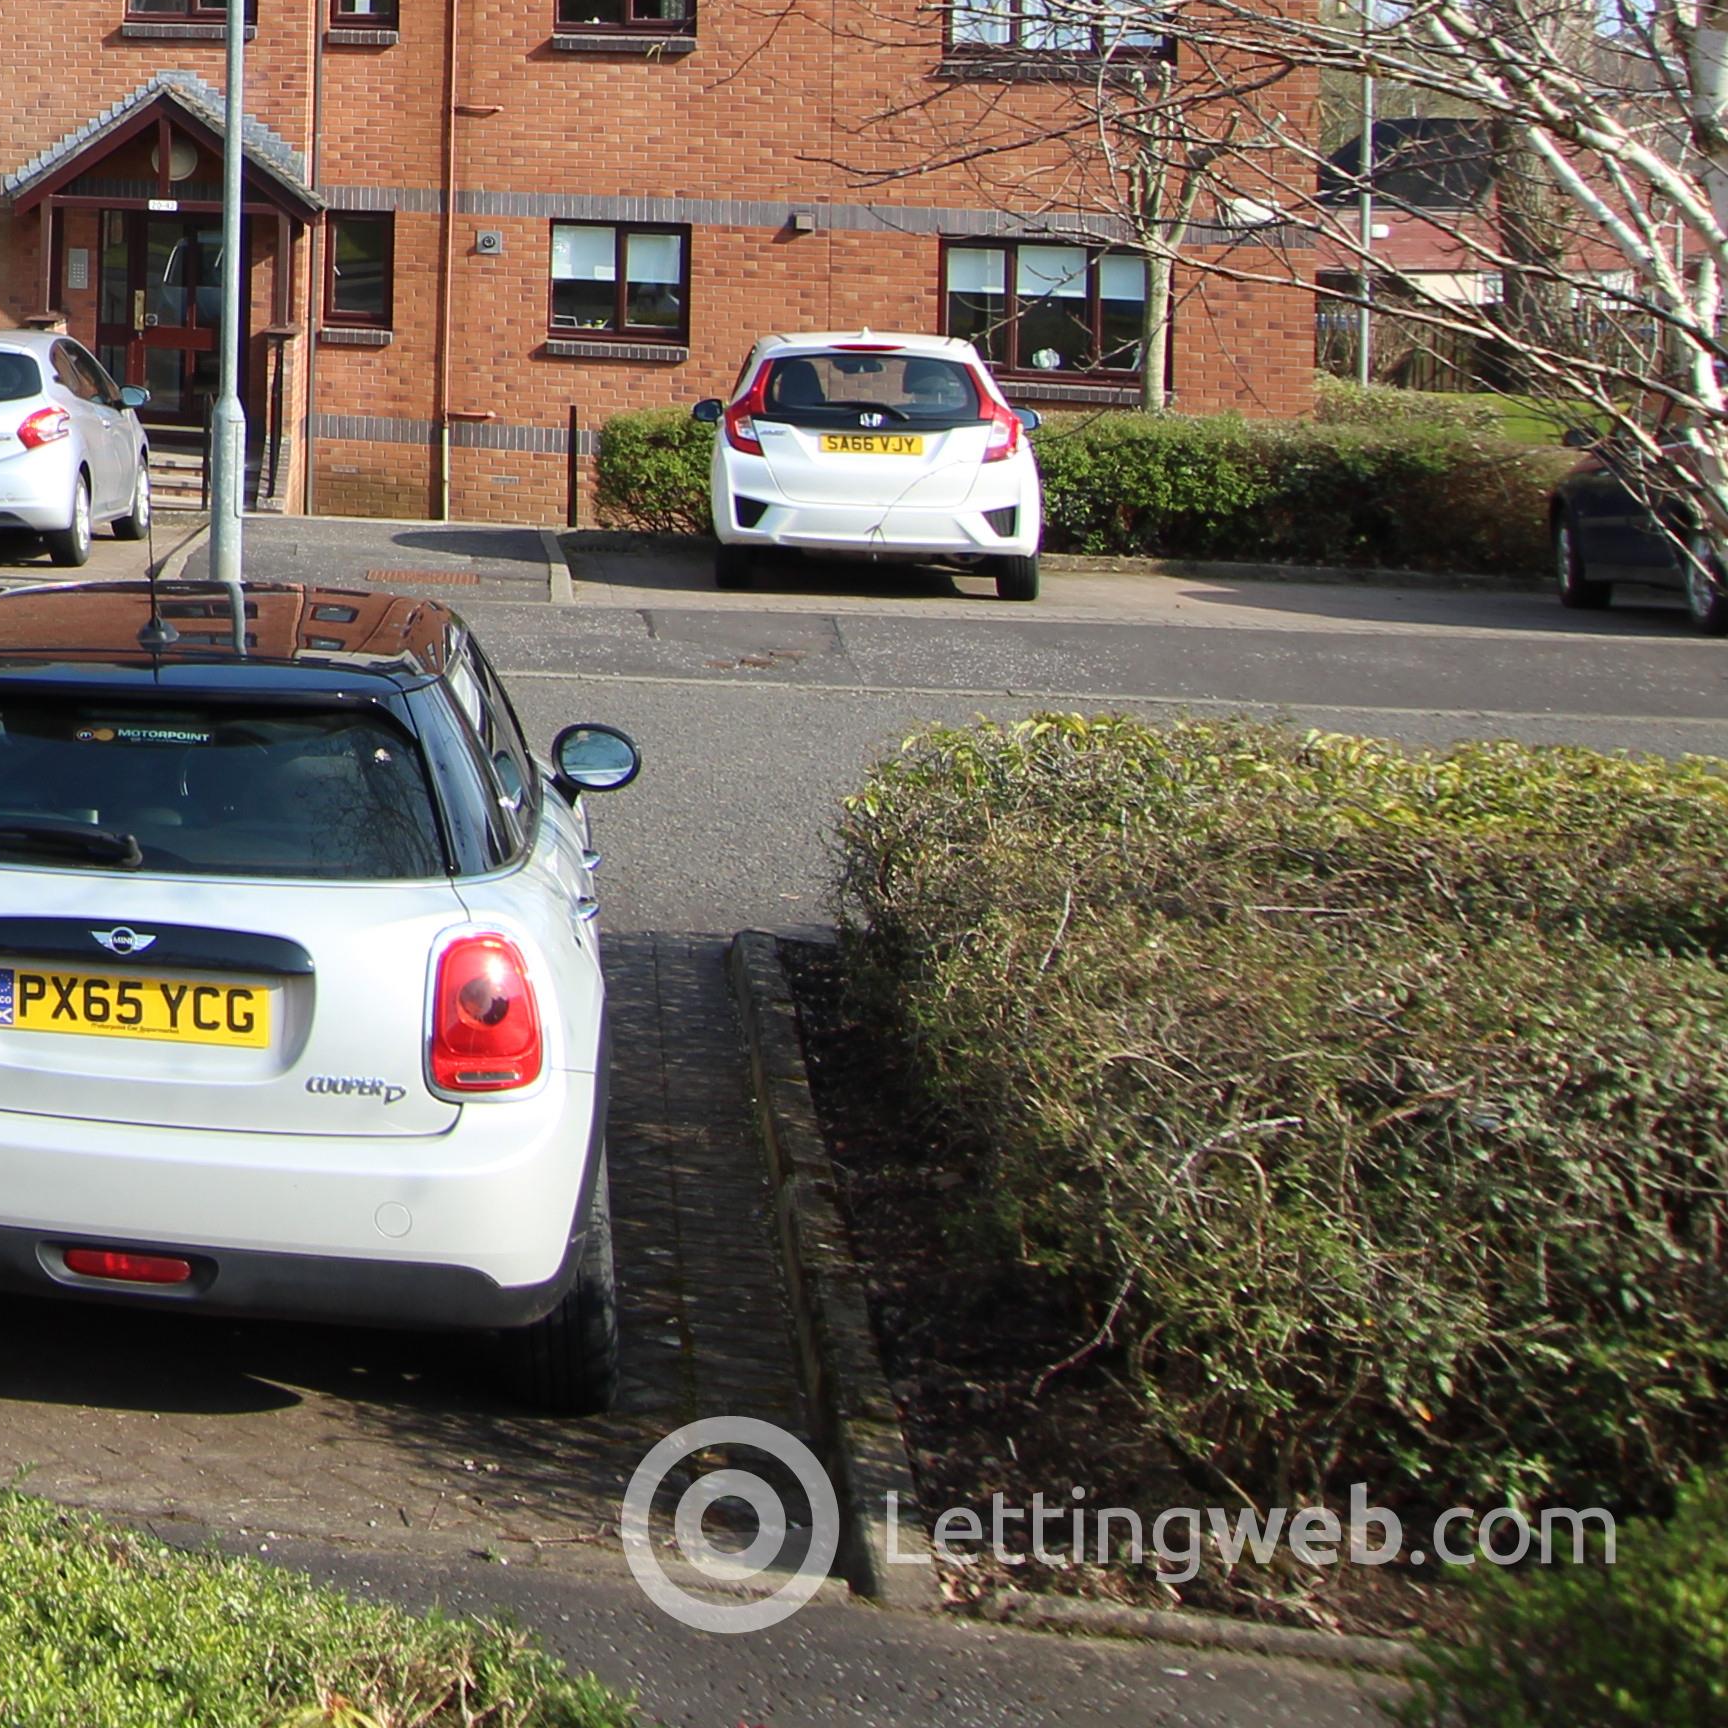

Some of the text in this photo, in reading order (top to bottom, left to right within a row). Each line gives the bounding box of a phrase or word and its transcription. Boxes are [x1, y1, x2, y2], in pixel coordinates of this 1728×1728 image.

[827, 435, 915, 453] SA66 VJY
[117, 728, 210, 742] MOTORPOINT
[113, 935, 134, 945] MINI
[18, 974, 255, 1034] PX65 YCG
[305, 1076, 407, 1106] COOPER D
